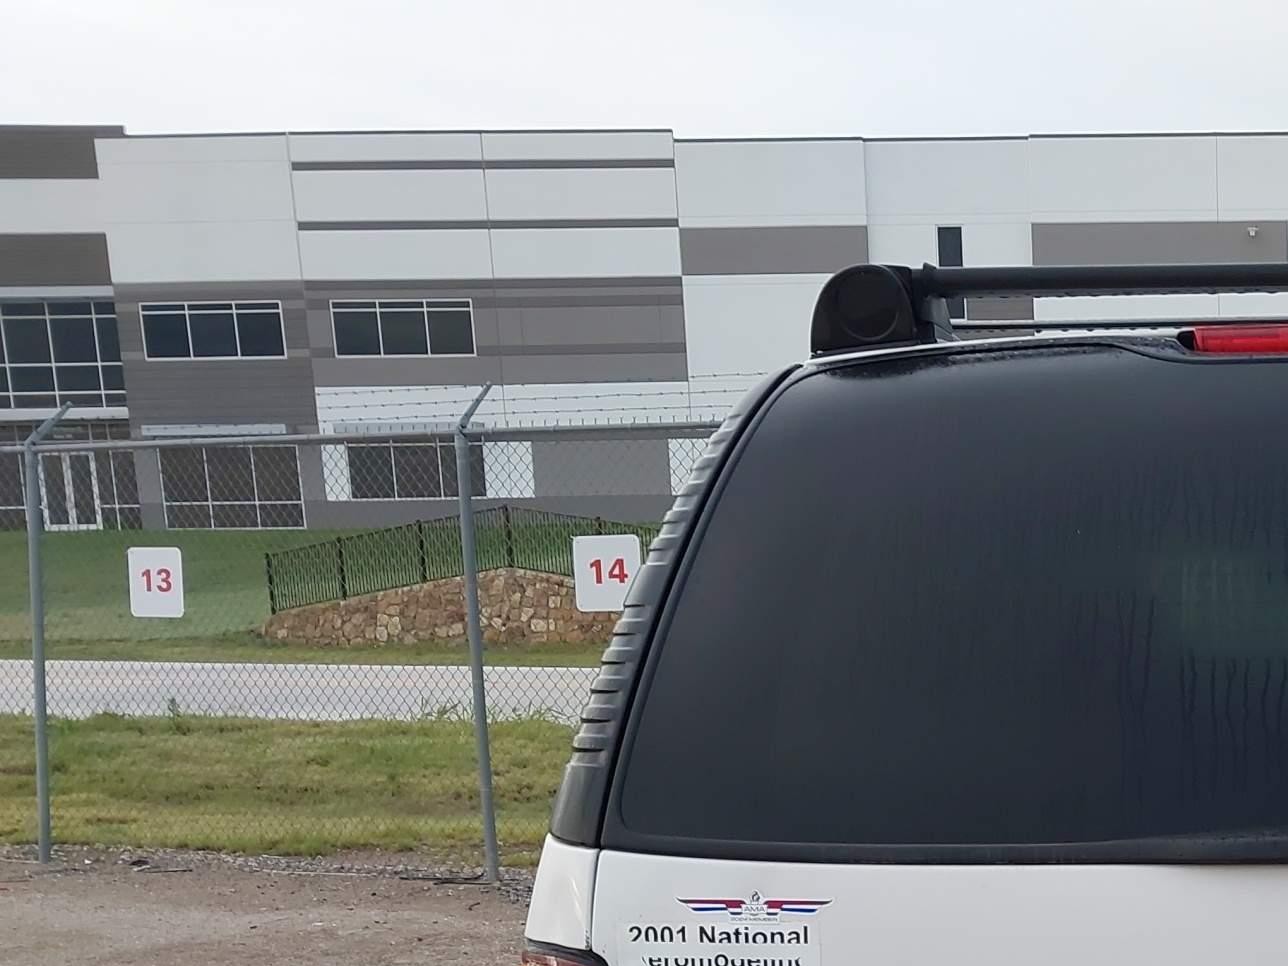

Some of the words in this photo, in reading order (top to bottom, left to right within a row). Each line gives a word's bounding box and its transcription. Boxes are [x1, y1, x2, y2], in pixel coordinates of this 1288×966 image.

[141, 568, 172, 592] 13
[589, 558, 628, 585] 14
[628, 926, 686, 943] 2001
[699, 926, 809, 944] National
